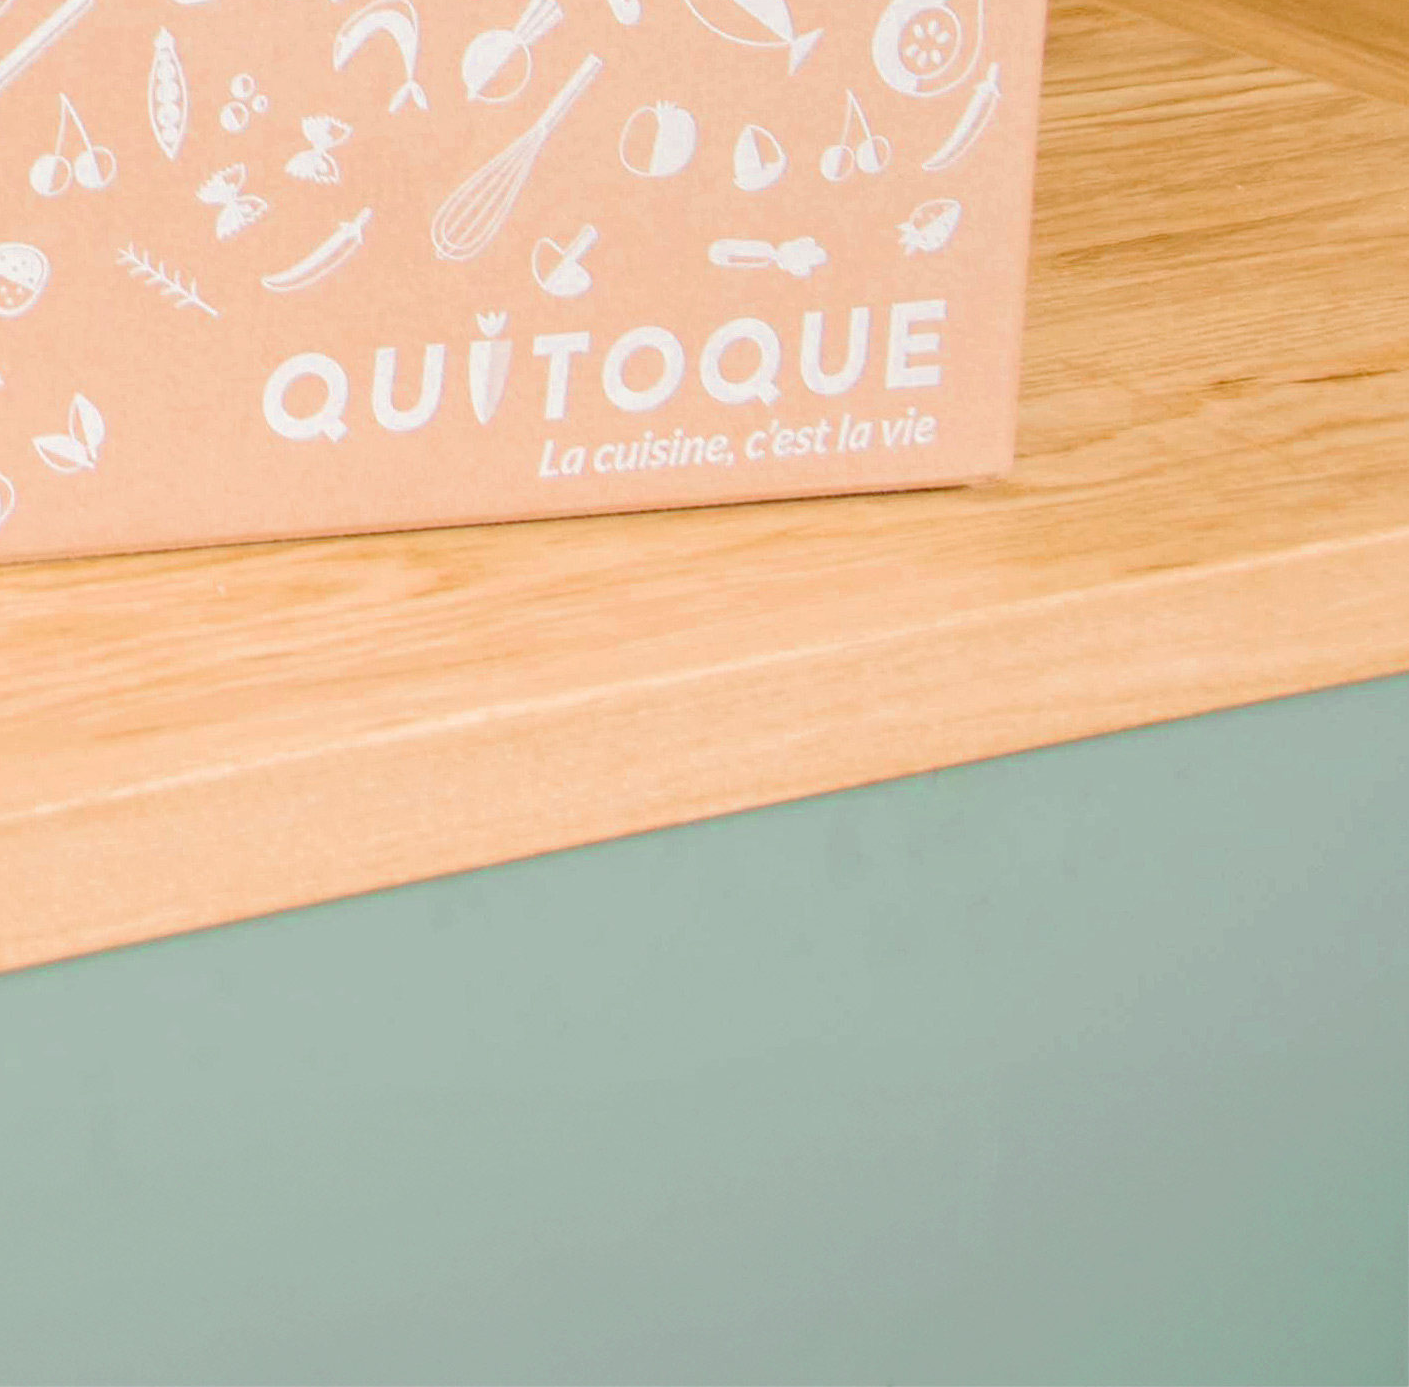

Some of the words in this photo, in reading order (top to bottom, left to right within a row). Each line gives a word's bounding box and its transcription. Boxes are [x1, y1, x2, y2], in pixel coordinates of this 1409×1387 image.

[261, 298, 947, 443] QUITOQUE
[538, 439, 586, 478] La
[592, 426, 735, 474] cuisine,
[837, 411, 873, 452] la
[882, 408, 937, 446] vie
